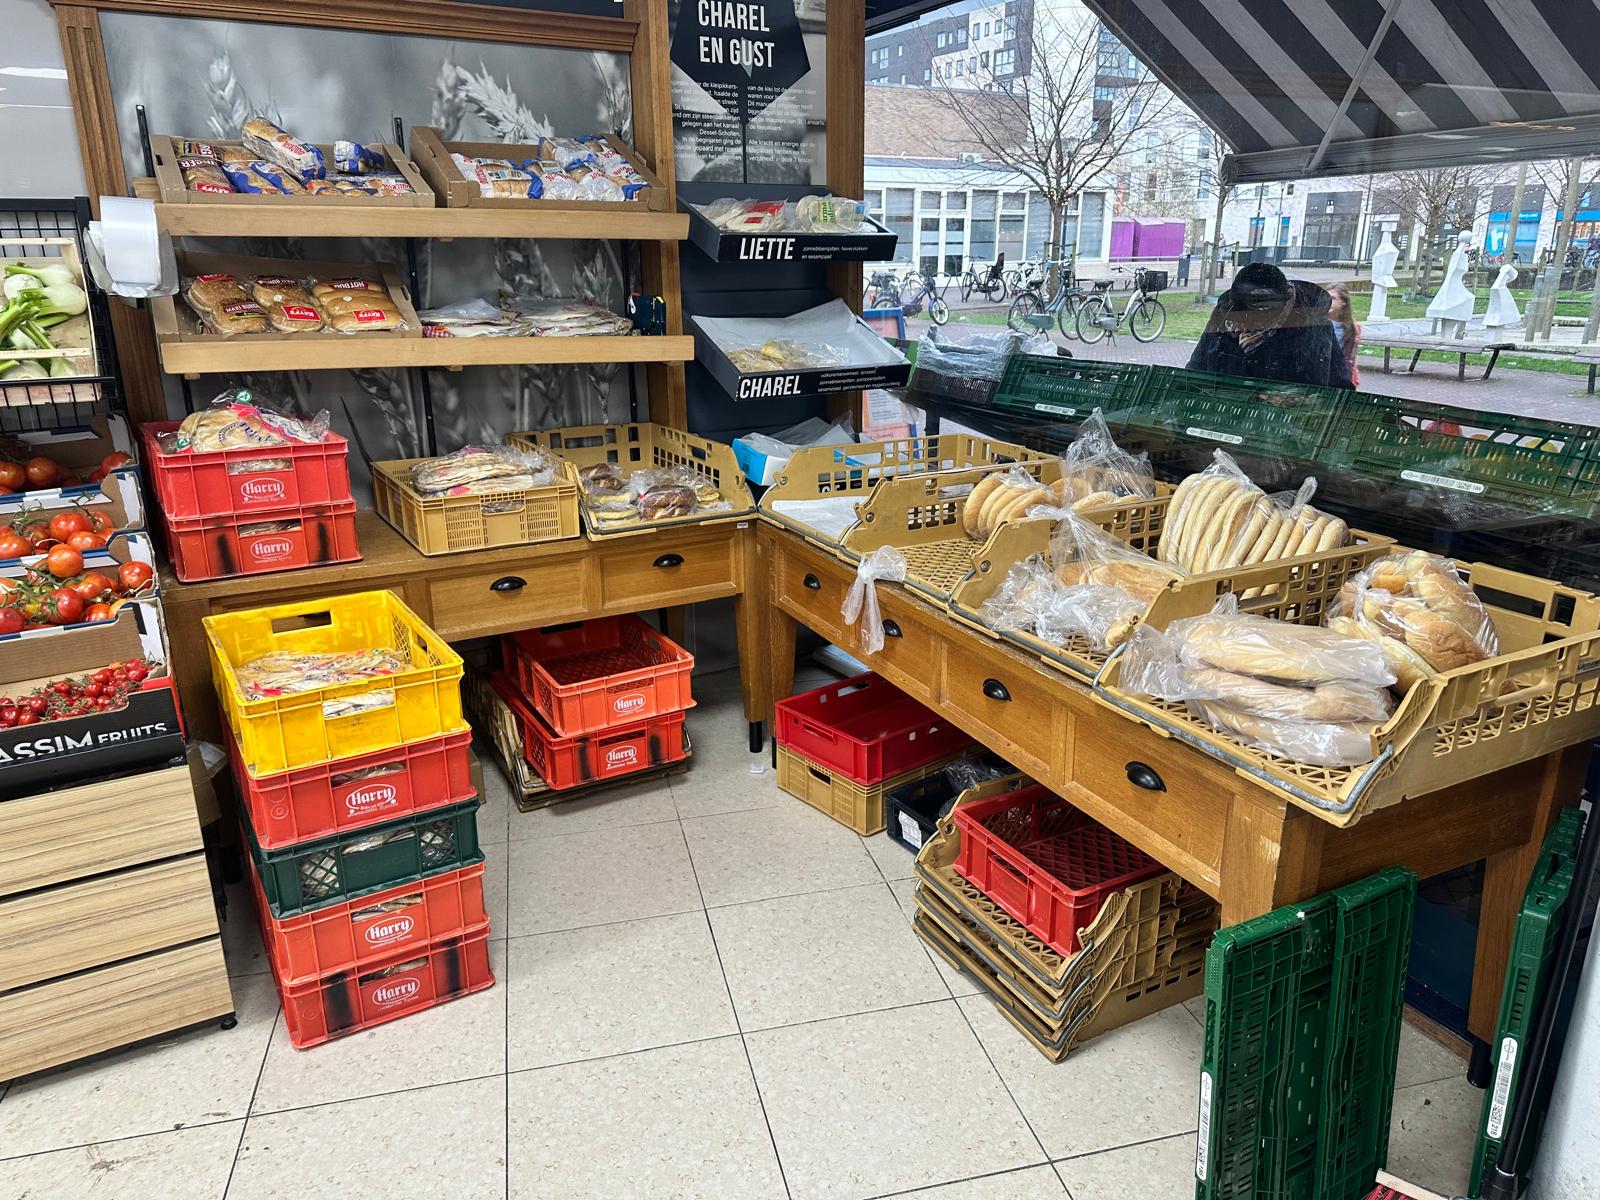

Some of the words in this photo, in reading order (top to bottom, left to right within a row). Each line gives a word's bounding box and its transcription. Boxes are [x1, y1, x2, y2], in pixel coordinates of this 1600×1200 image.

[698, 0, 770, 32] CHAREL
[699, 36, 724, 64] EN
[730, 38, 775, 68] GUST
[739, 237, 796, 260] LIETTE
[739, 375, 801, 399] CHAREL
[245, 482, 281, 496] Harry
[254, 542, 290, 555] Harry
[616, 697, 644, 710] Harry
[608, 748, 634, 762] Harry
[351, 787, 392, 806] Harry
[369, 920, 410, 939] Harry
[376, 981, 416, 1002] Harry
